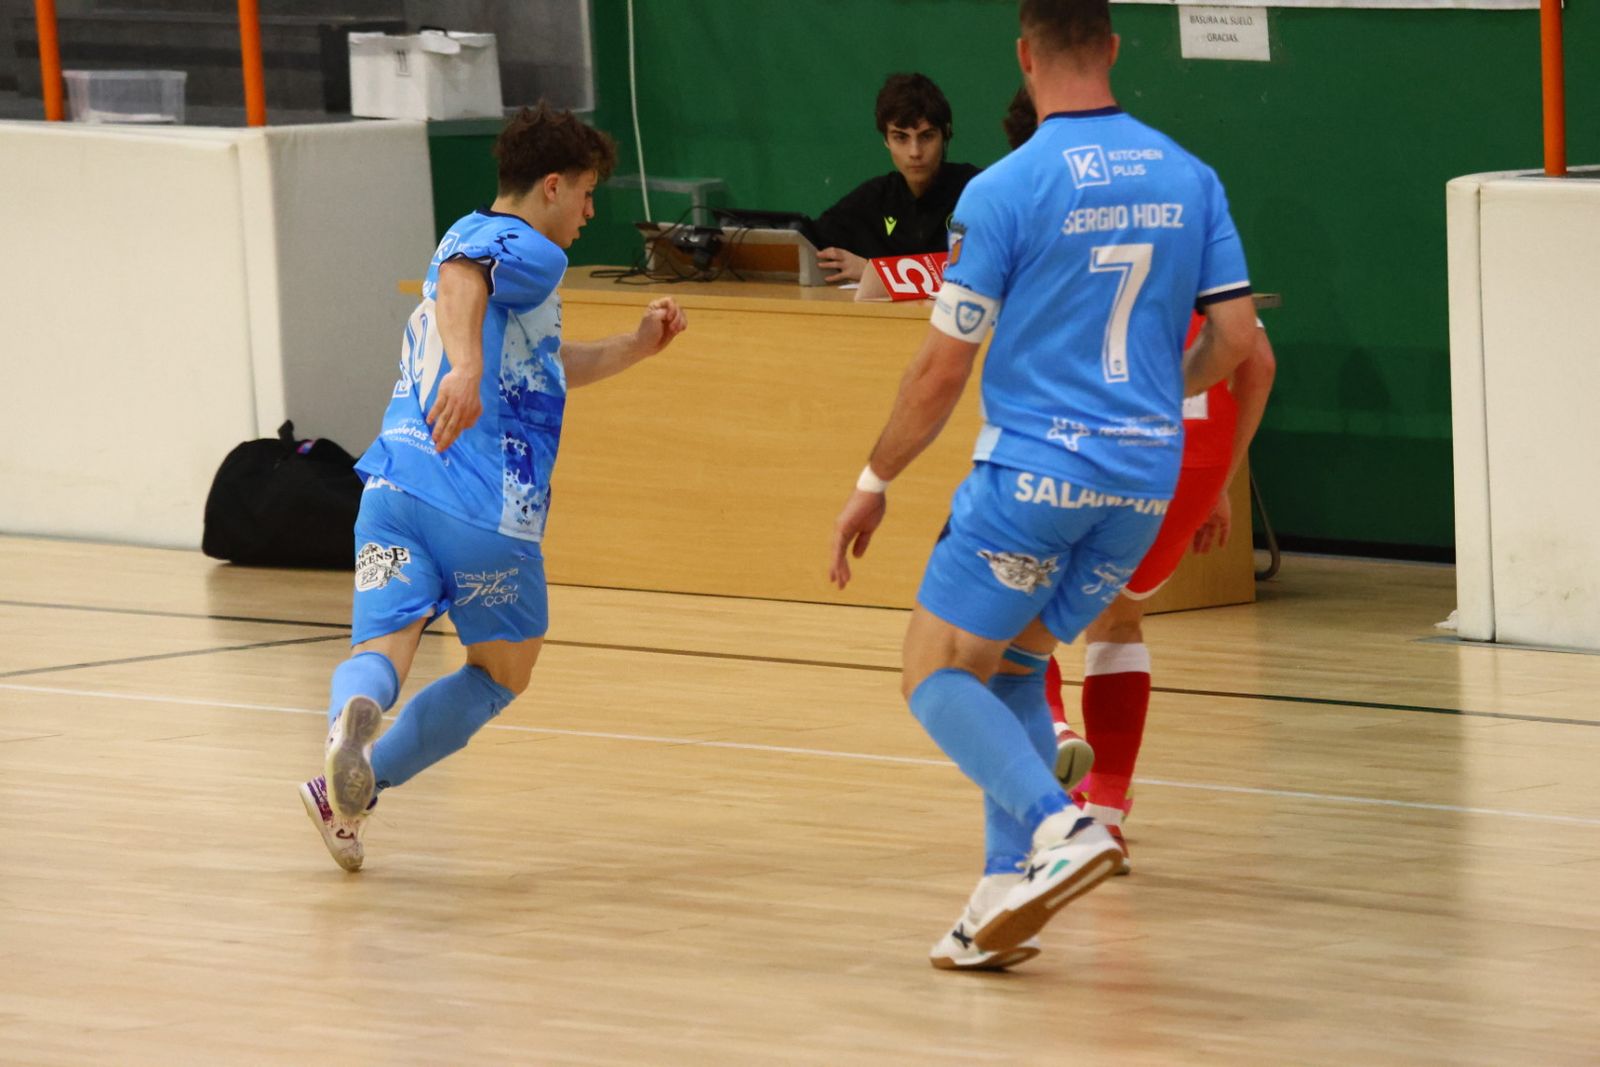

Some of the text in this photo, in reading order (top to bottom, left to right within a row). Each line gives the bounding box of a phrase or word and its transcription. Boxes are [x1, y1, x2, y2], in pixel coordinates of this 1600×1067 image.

[1189, 15, 1218, 25] BASURA
[1219, 16, 1229, 25] AL
[1107, 148, 1164, 161] KITCHEN
[1112, 163, 1147, 177] PLUS
[1062, 202, 1185, 235] SERGIO HDEZ
[1088, 242, 1155, 385] 7
